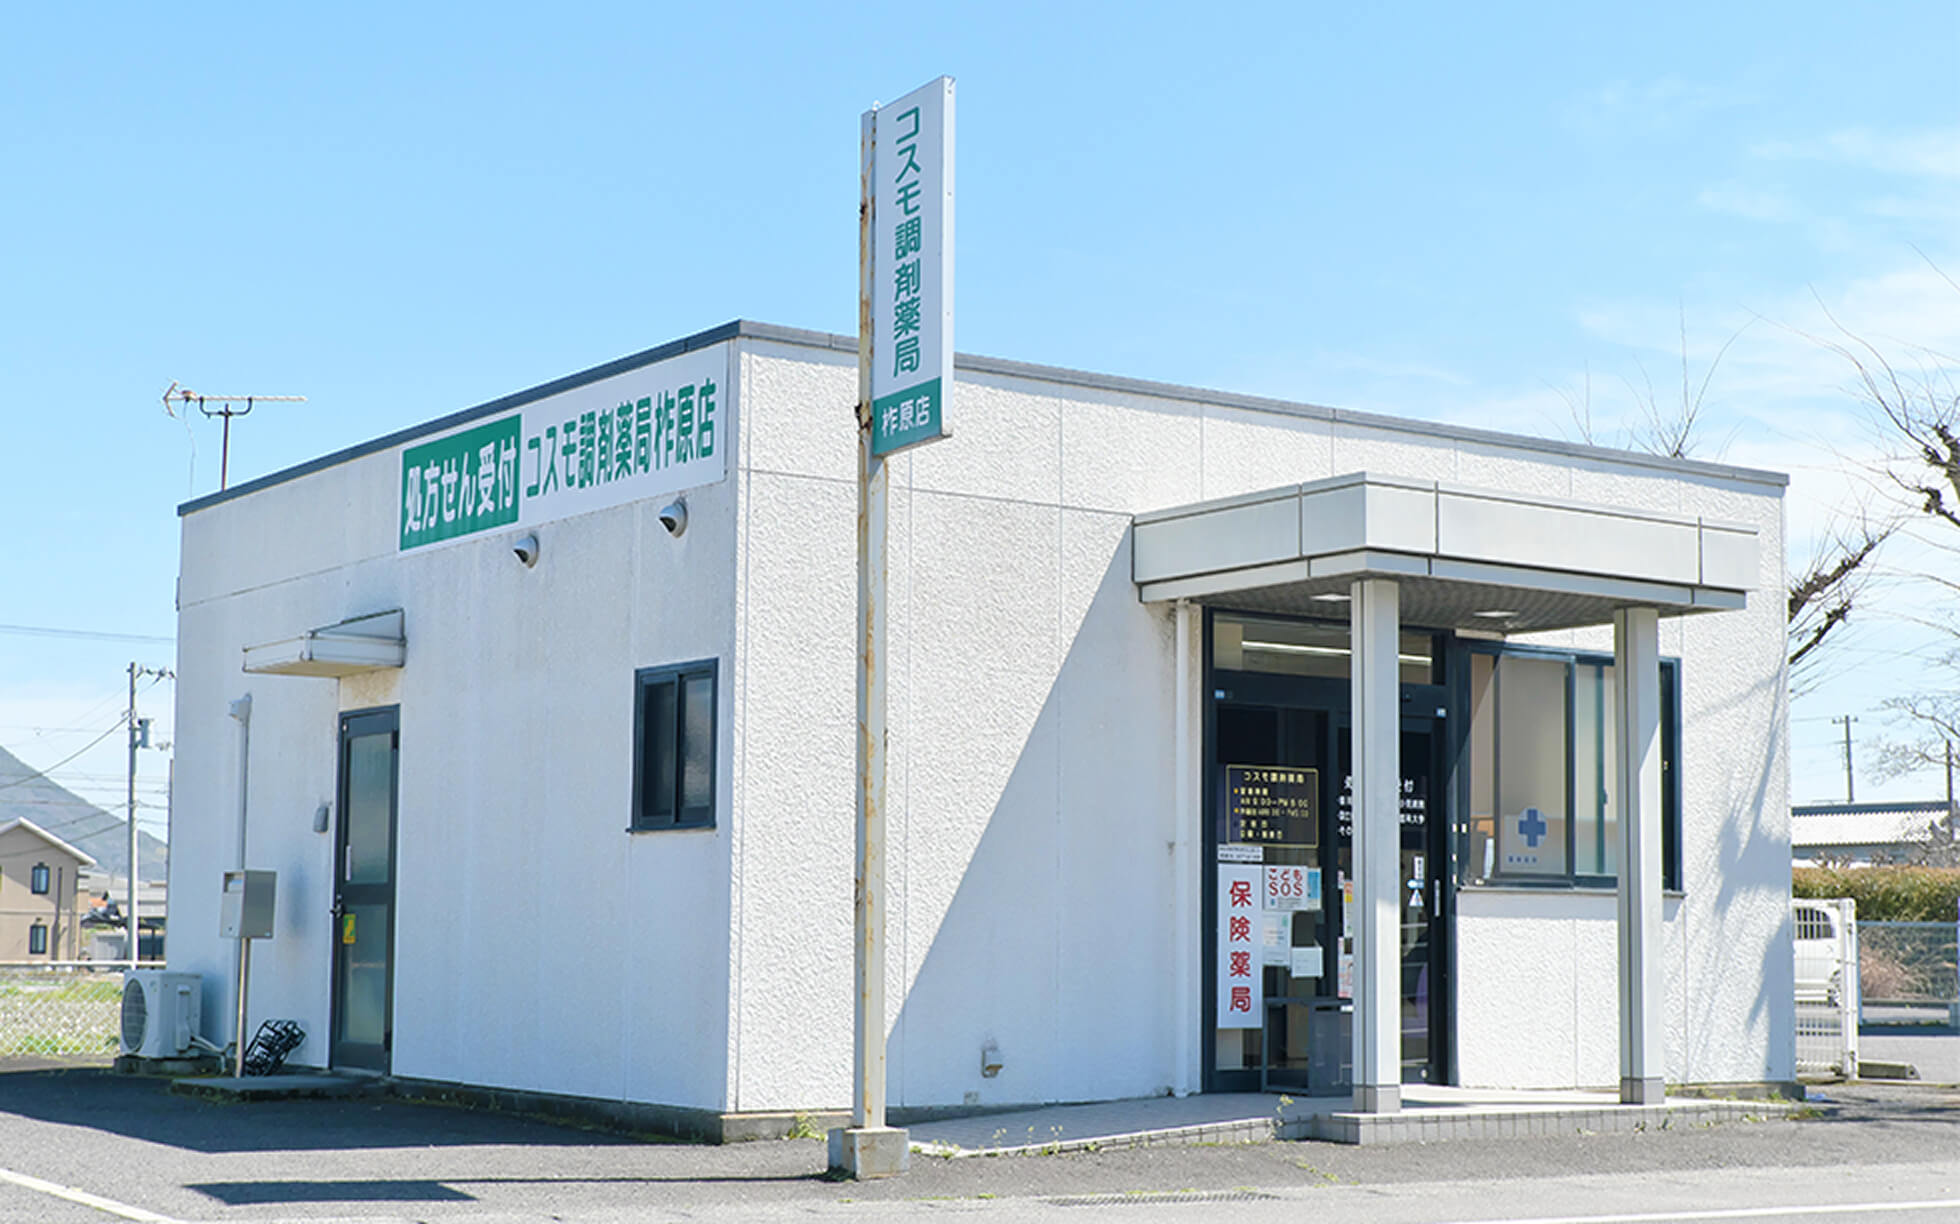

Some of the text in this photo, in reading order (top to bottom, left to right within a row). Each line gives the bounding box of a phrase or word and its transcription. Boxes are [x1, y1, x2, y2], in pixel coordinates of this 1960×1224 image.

[894, 105, 922, 378] コスモ調剤薬局
[525, 377, 717, 499] コスモ調剤薬局柞原店
[881, 395, 931, 438] 柞原店
[404, 435, 518, 535] 処方せん受付
[1268, 868, 1303, 881] こども
[1268, 881, 1303, 897] SOS
[1229, 880, 1253, 1013] 保険薬局
